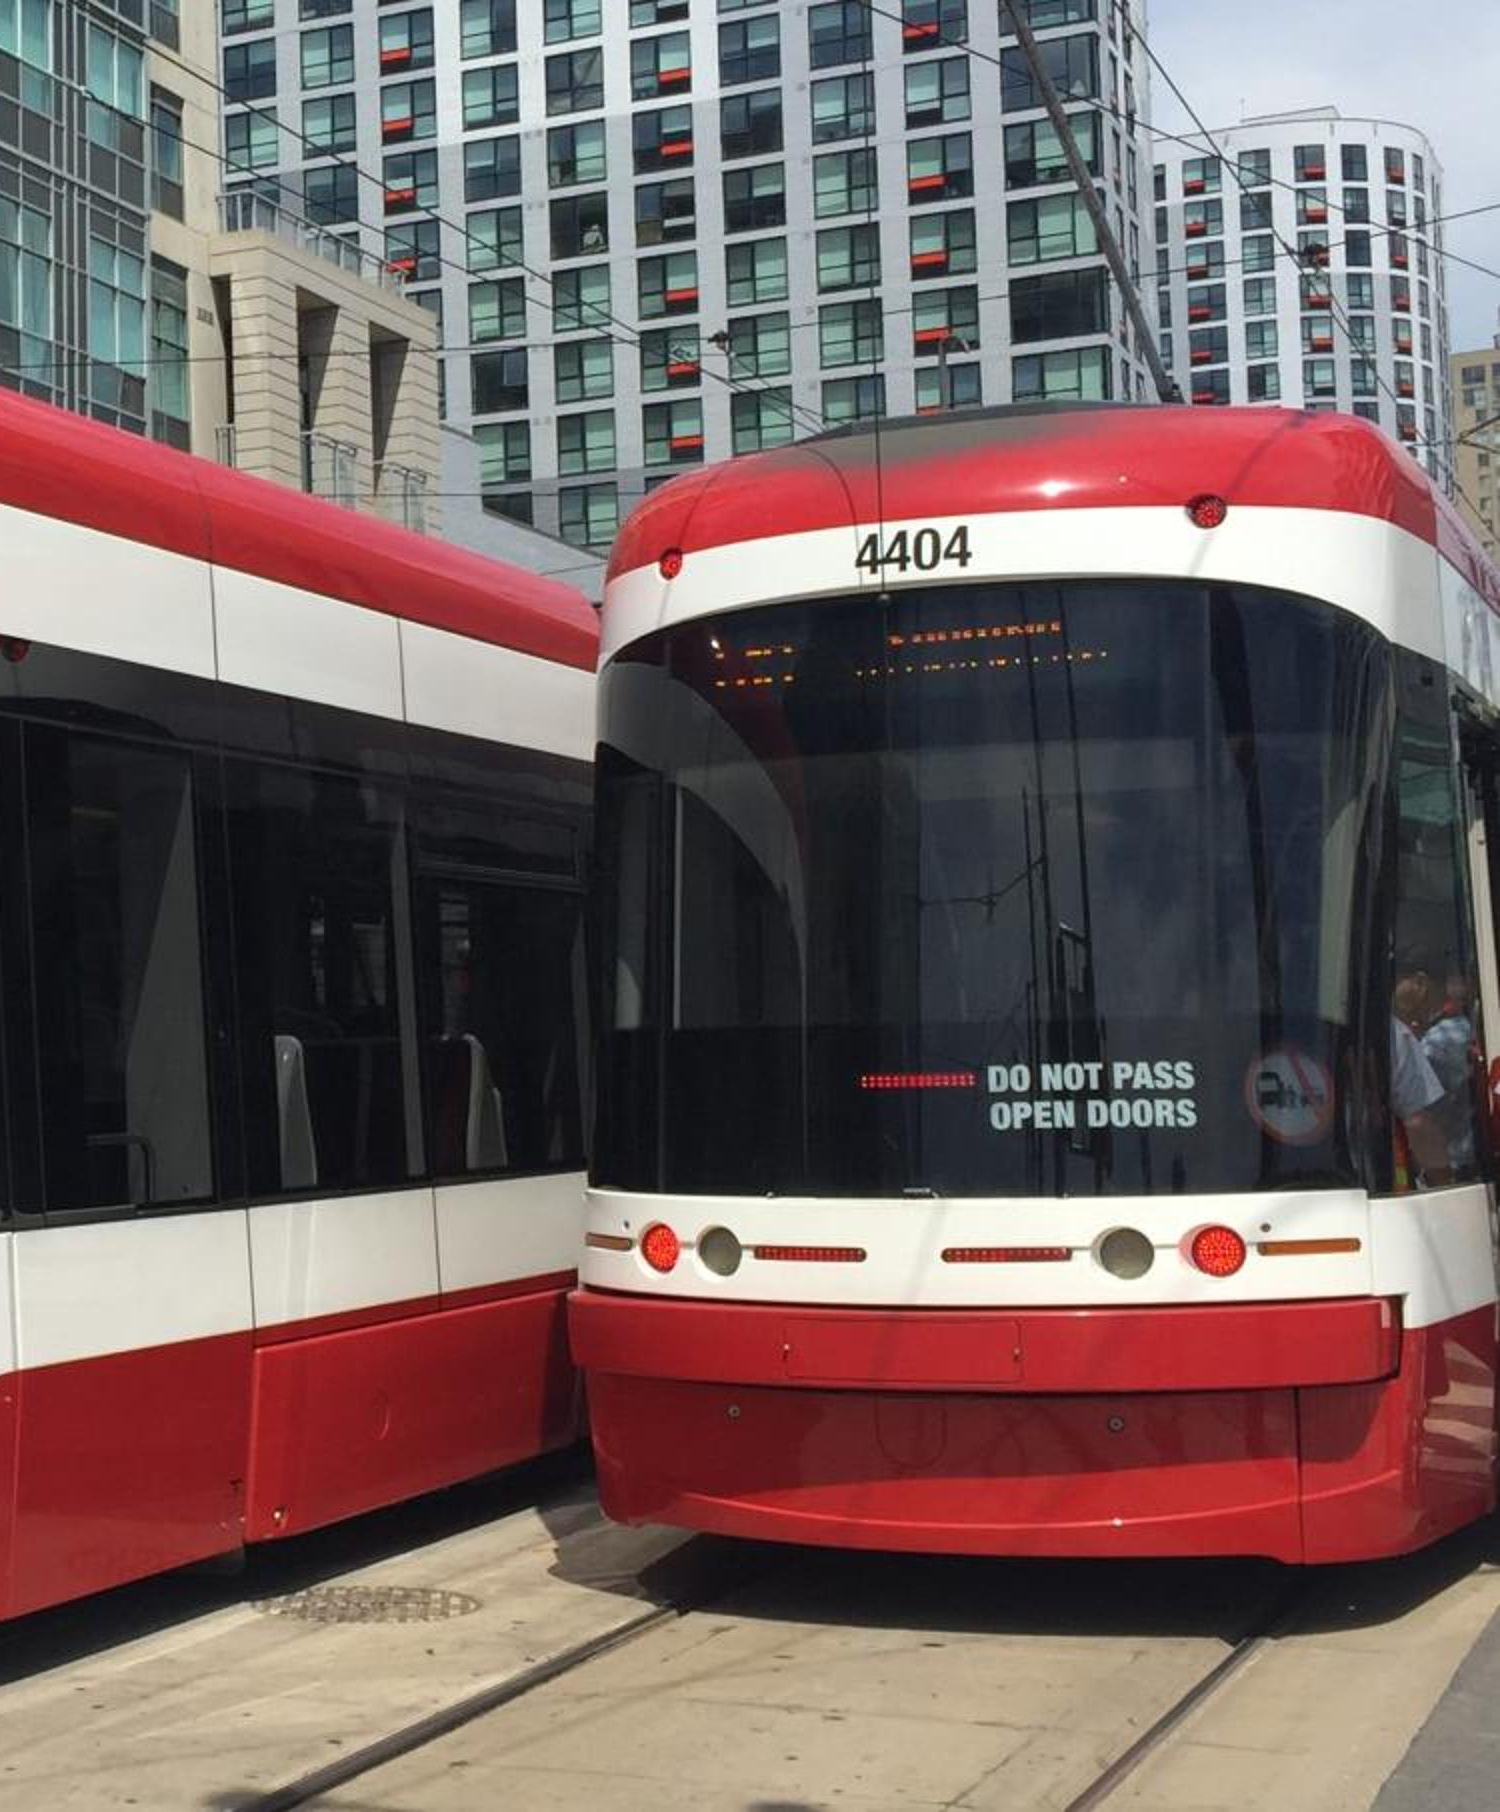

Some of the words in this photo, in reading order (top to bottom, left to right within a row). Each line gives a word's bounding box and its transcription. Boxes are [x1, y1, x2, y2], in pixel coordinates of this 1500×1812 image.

[855, 525, 972, 574] 4404
[987, 1064, 1031, 1093] DO
[1041, 1062, 1103, 1091] NOT
[1112, 1061, 1195, 1089] PASS
[990, 1100, 1076, 1130] OPEN
[1087, 1099, 1197, 1128] DOORS
